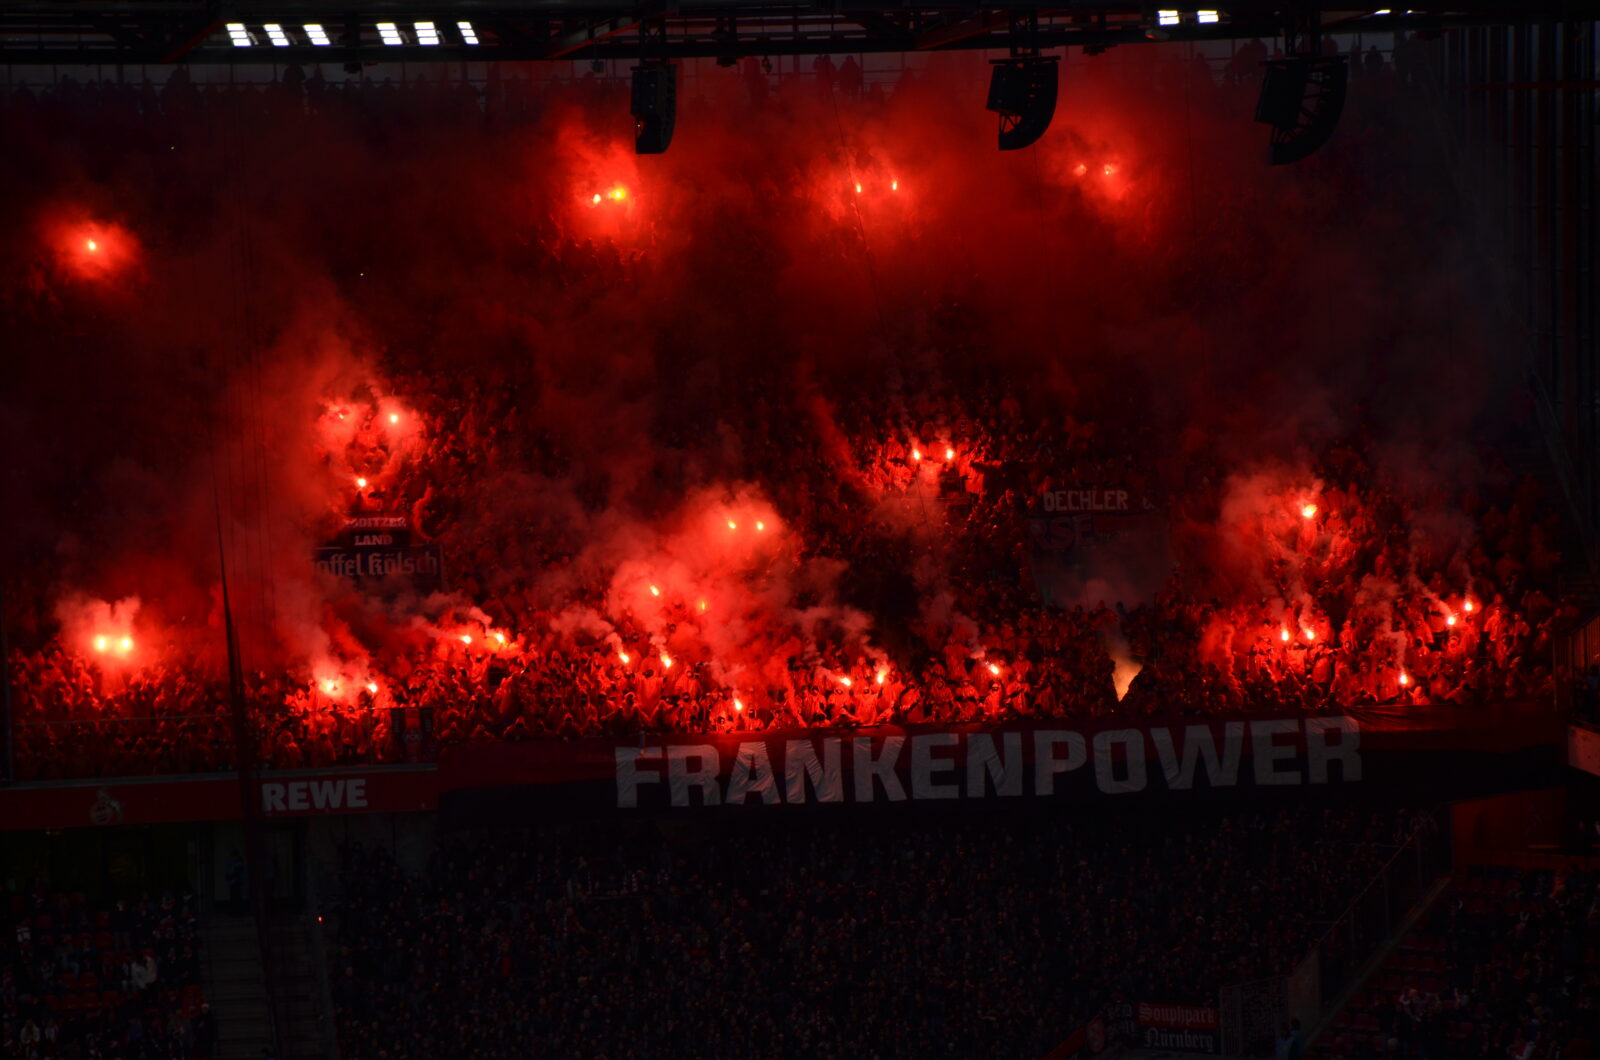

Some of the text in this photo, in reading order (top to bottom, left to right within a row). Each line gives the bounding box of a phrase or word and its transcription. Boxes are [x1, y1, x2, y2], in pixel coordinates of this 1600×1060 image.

[354, 534, 393, 547] LAND
[368, 549, 439, 577] Kölsch
[615, 715, 1363, 809] FRANKENPOWER
[262, 778, 369, 812] REWE
[1144, 1027, 1213, 1053] Nürnberg
